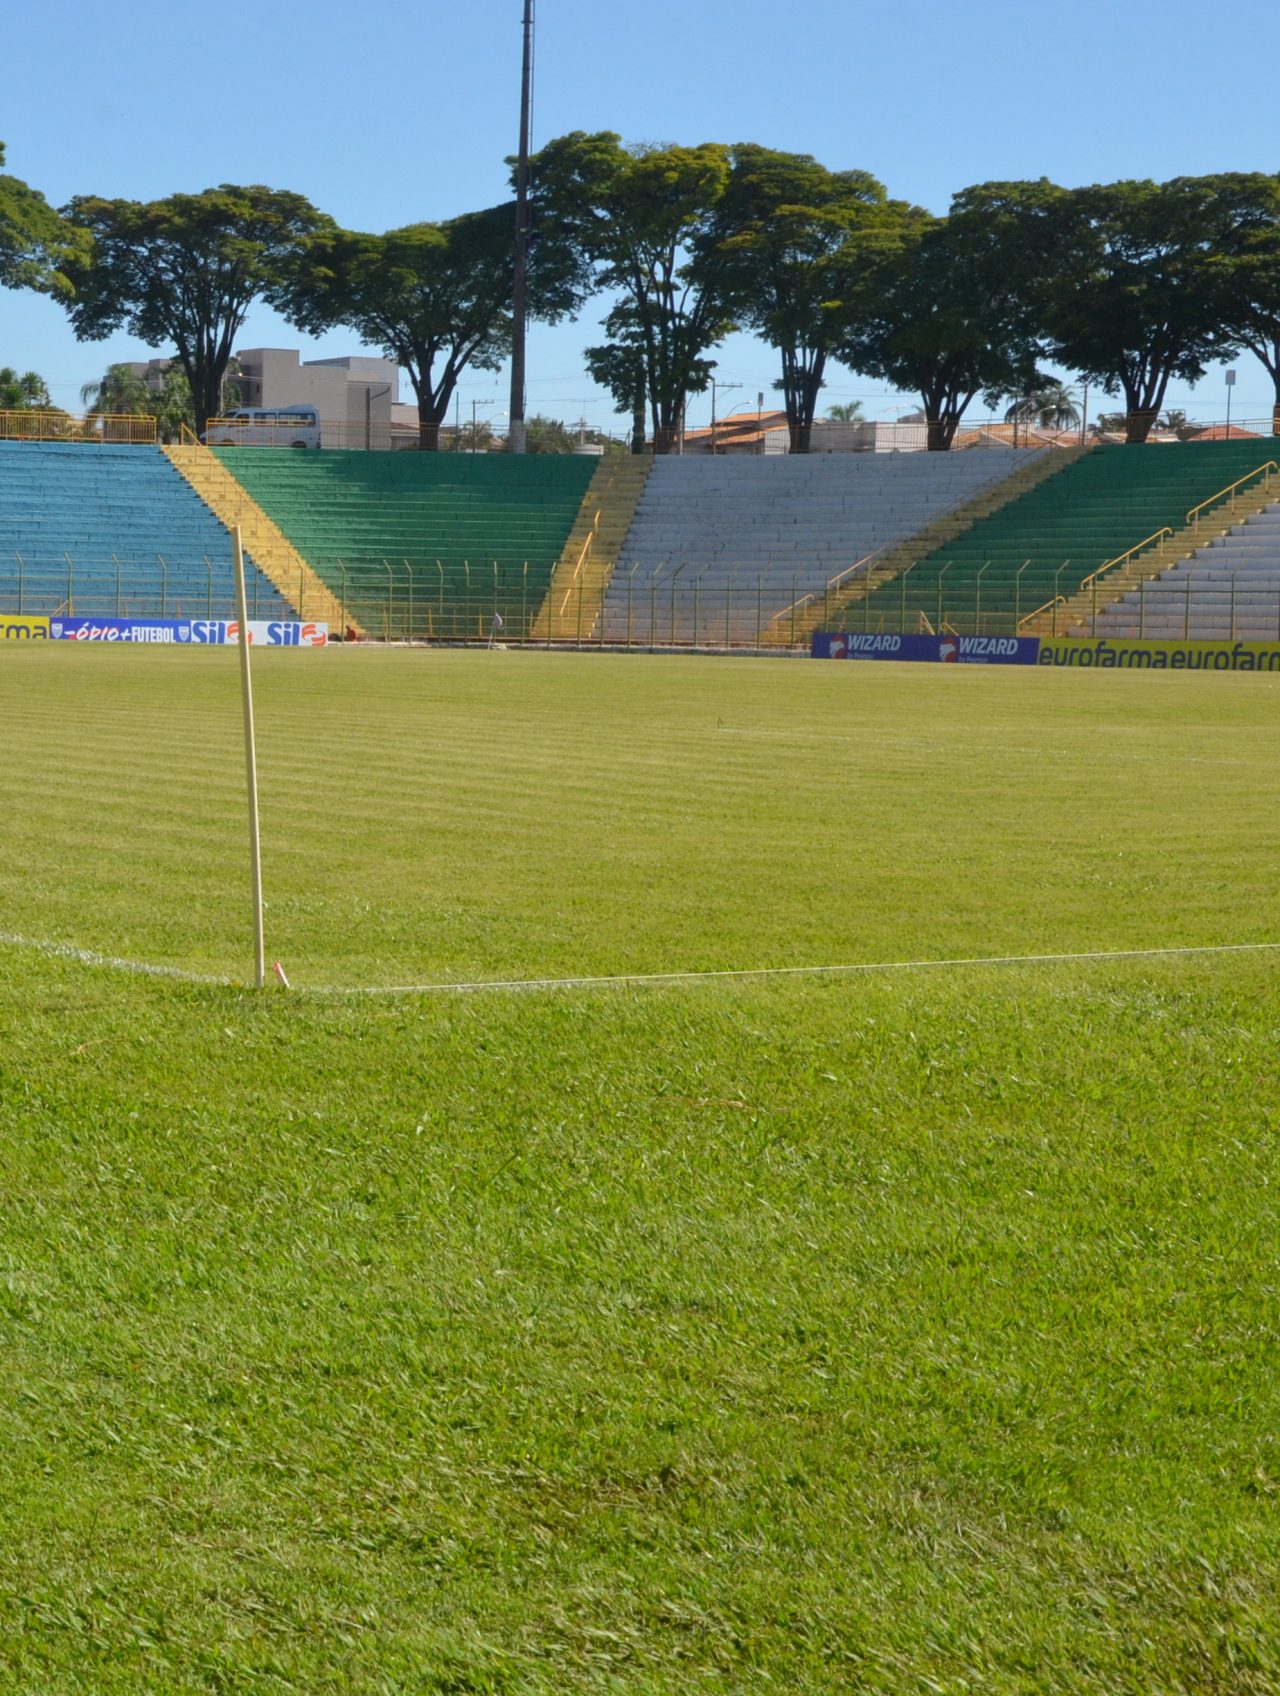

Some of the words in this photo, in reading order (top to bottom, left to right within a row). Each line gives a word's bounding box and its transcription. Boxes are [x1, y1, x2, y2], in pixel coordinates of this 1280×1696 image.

[192, 621, 226, 644] Sil
[266, 622, 301, 646] Sil
[847, 635, 901, 651] WIZARD
[959, 637, 1018, 655] WIZARD
[1038, 641, 1167, 668] eurofarma
